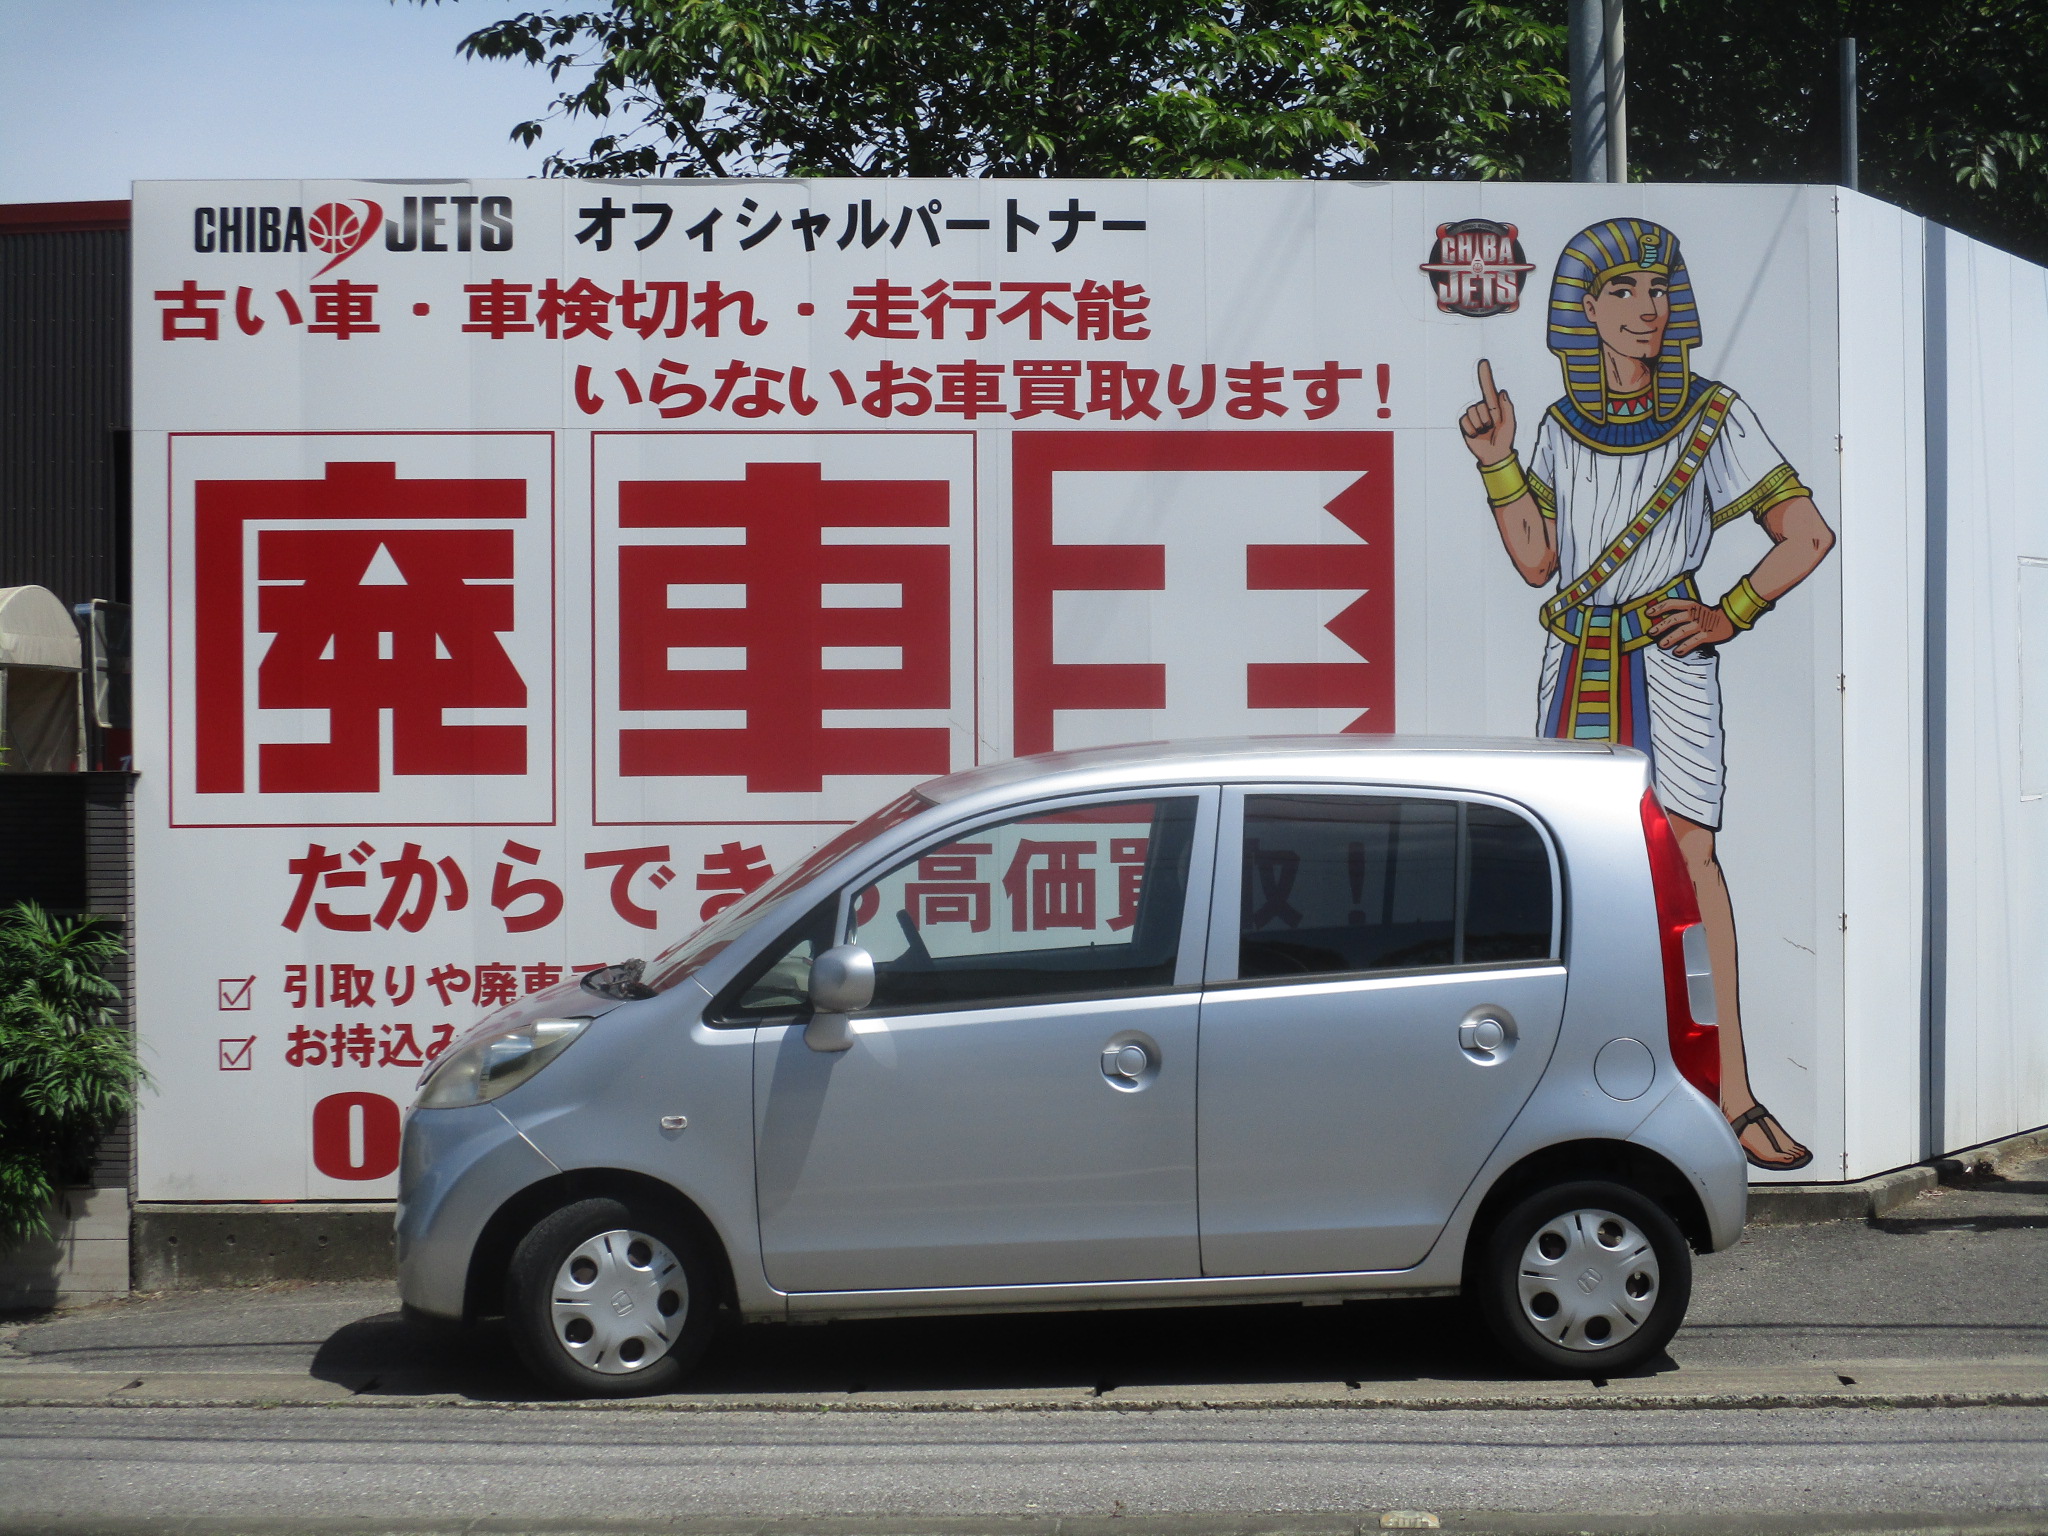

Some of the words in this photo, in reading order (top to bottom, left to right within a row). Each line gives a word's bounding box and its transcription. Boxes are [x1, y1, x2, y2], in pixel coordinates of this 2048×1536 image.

[194, 206, 306, 253] CHIBA
[385, 196, 513, 252] JETS
[575, 197, 1147, 253] オフィシャルパートナー
[1441, 234, 1514, 264] CHIBA
[1438, 270, 1517, 307] JETS
[284, 962, 607, 1008] 引取りや廃車
